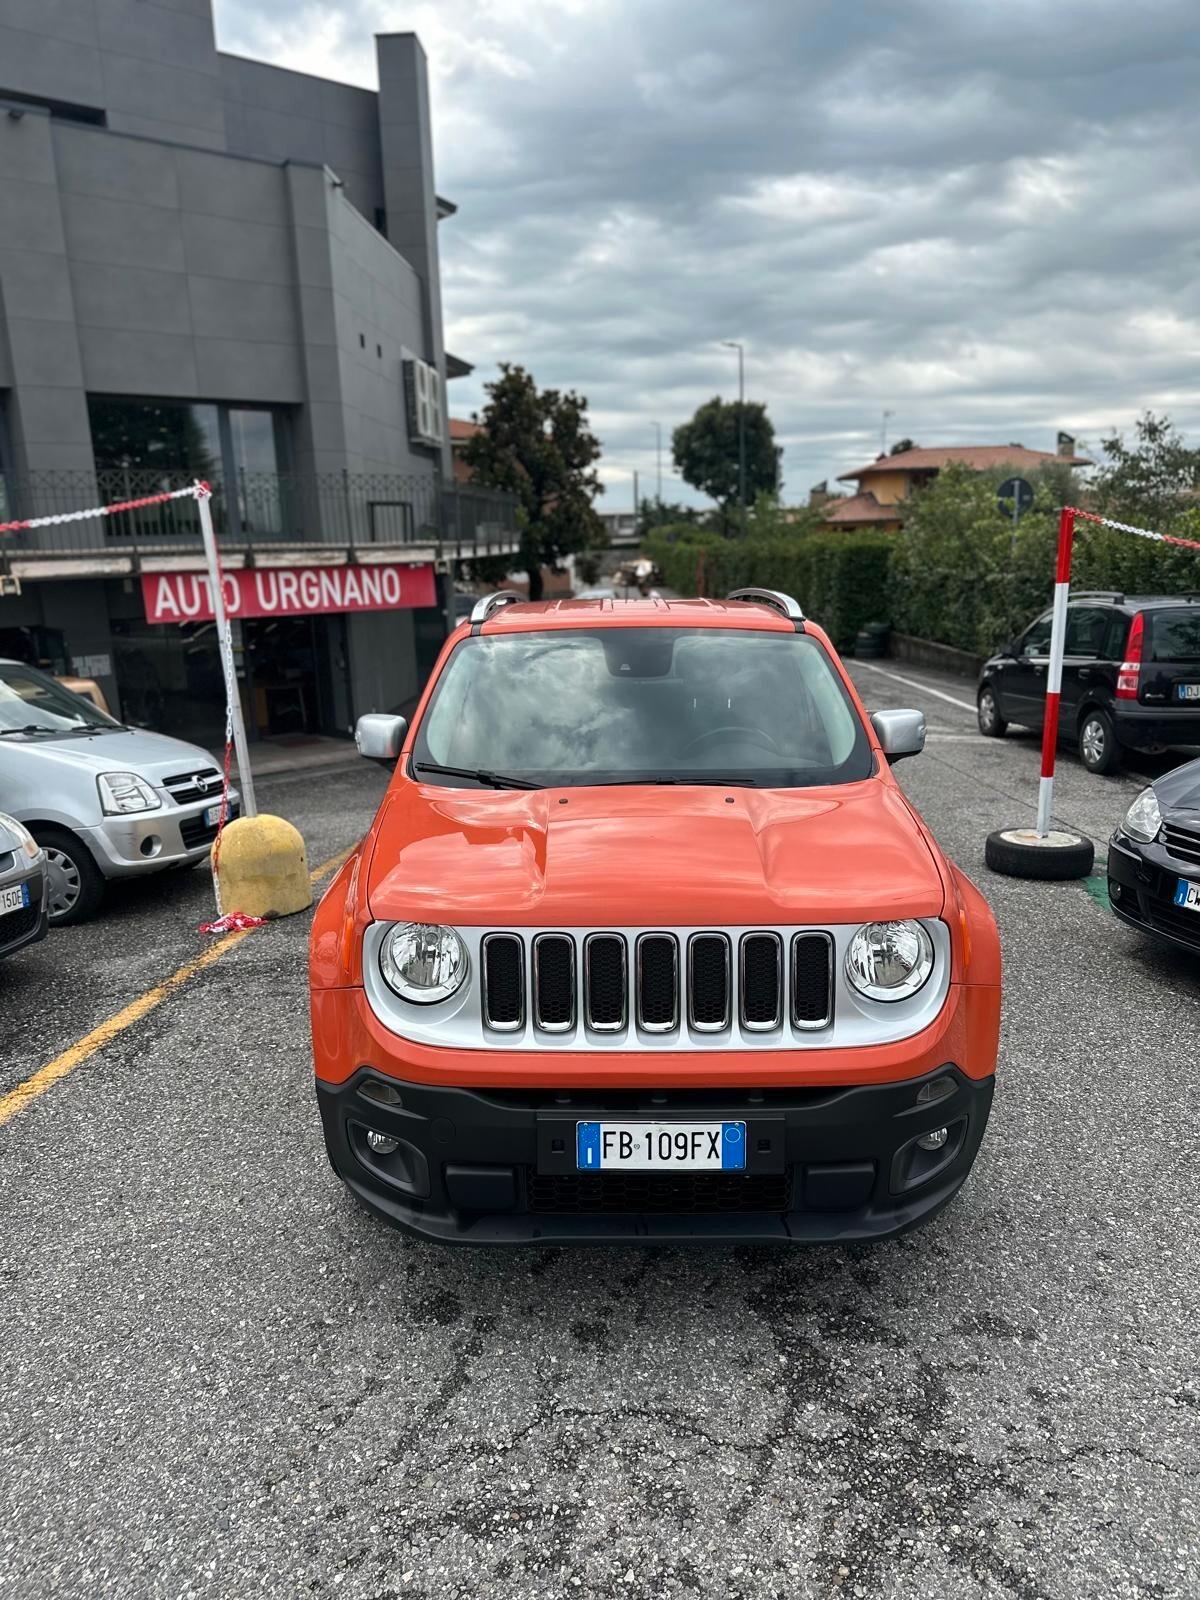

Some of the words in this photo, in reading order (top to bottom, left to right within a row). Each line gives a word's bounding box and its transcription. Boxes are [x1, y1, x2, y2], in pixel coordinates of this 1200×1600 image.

[154, 574, 241, 617] AUTO
[255, 568, 401, 611] URGNANO
[603, 1131, 633, 1160] FB
[645, 1131, 720, 1161] 109FX
